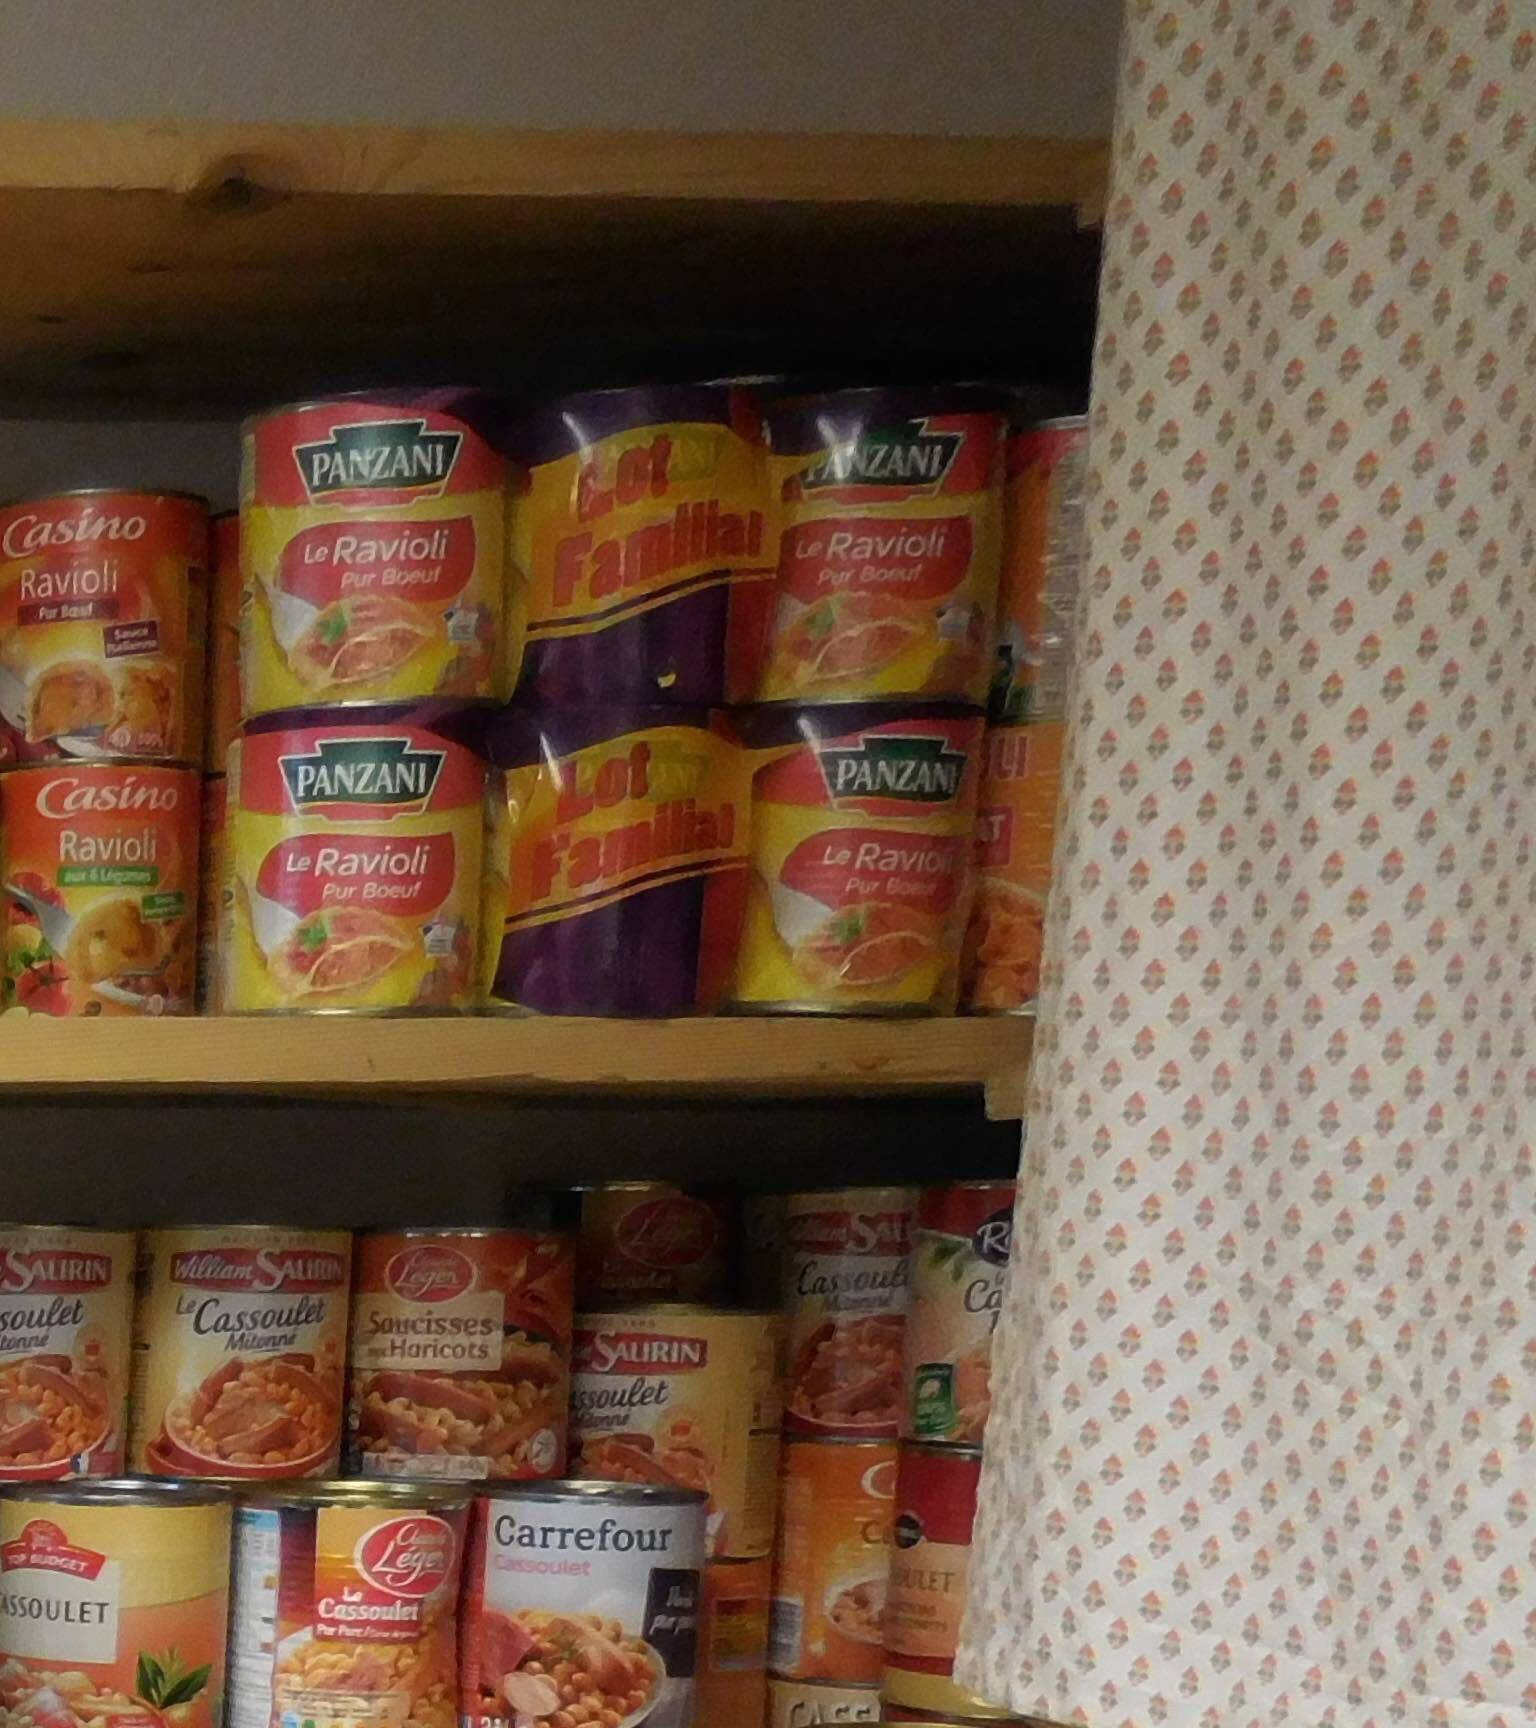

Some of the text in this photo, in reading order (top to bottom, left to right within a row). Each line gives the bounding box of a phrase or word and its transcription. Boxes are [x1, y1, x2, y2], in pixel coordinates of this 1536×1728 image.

[311, 444, 446, 487] PANZANI
[577, 434, 674, 521] Lot
[1, 508, 148, 559] Casino
[304, 529, 449, 565] Le Ravioli
[828, 524, 947, 562] Ravioli
[553, 498, 764, 607] Familial
[20, 560, 118, 600] Ravioli
[341, 566, 442, 588] Pur Boeuf
[295, 761, 427, 797] PANZANI
[558, 740, 652, 822] Lot
[834, 760, 957, 795] PANZANI
[35, 774, 179, 819] Casino
[58, 828, 158, 864] Ravioli
[286, 844, 431, 878] Le Ravioli
[532, 799, 736, 900] Familial
[822, 844, 852, 866] Le
[322, 881, 422, 901] Pur Boeuf
[2, 1246, 110, 1292] SAURIN
[173, 1254, 254, 1281] William
[175, 1295, 328, 1336] Le Cassoulet
[368, 1311, 494, 1338] Saucisses
[389, 1337, 490, 1361] Haricots
[592, 1331, 701, 1371] SAURIN
[575, 1378, 670, 1411] ssoulet
[494, 1514, 673, 1553] Carrefour
[494, 1554, 592, 1577] Cassoulet
[317, 1597, 419, 1622] Cassoulet
